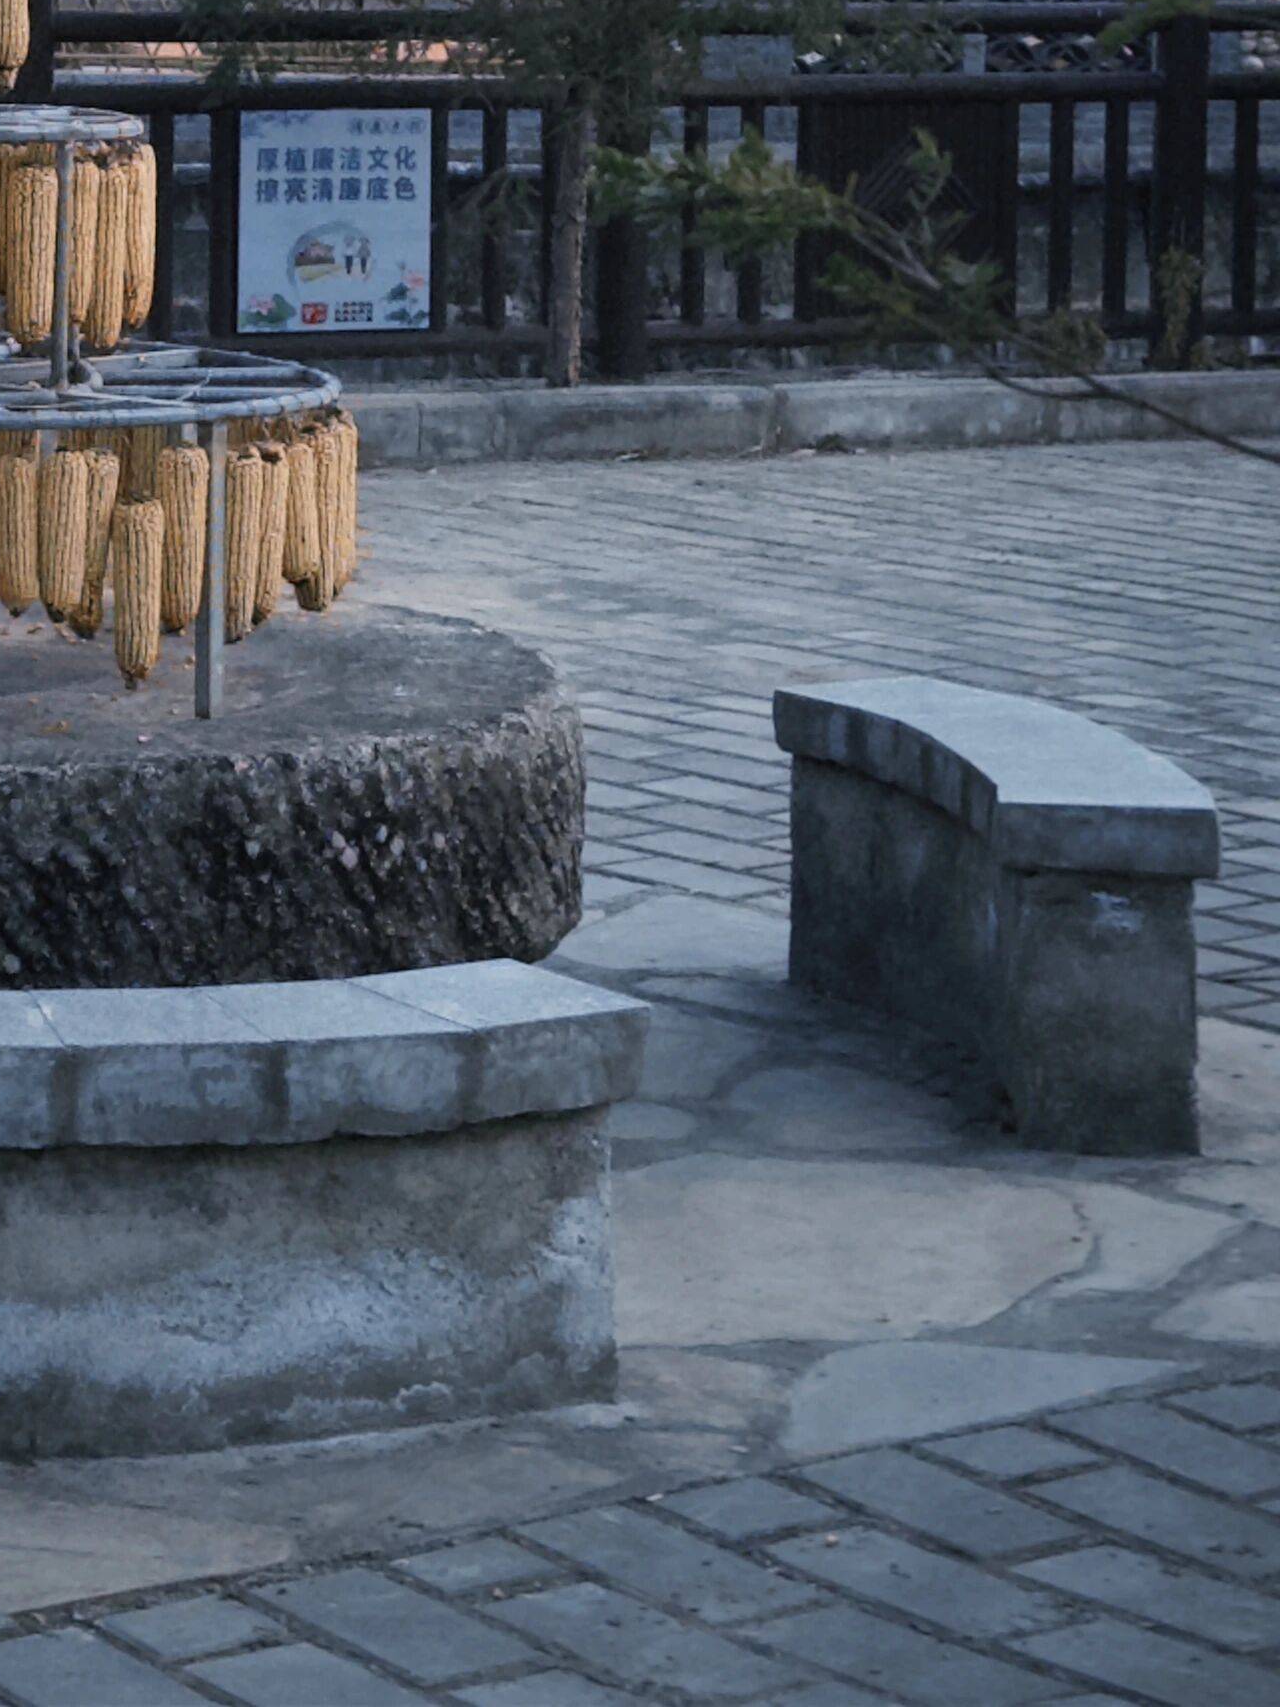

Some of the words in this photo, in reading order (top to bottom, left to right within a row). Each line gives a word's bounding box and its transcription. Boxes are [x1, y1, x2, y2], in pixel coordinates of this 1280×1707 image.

[256, 145, 417, 173] 厚植廉洁文化
